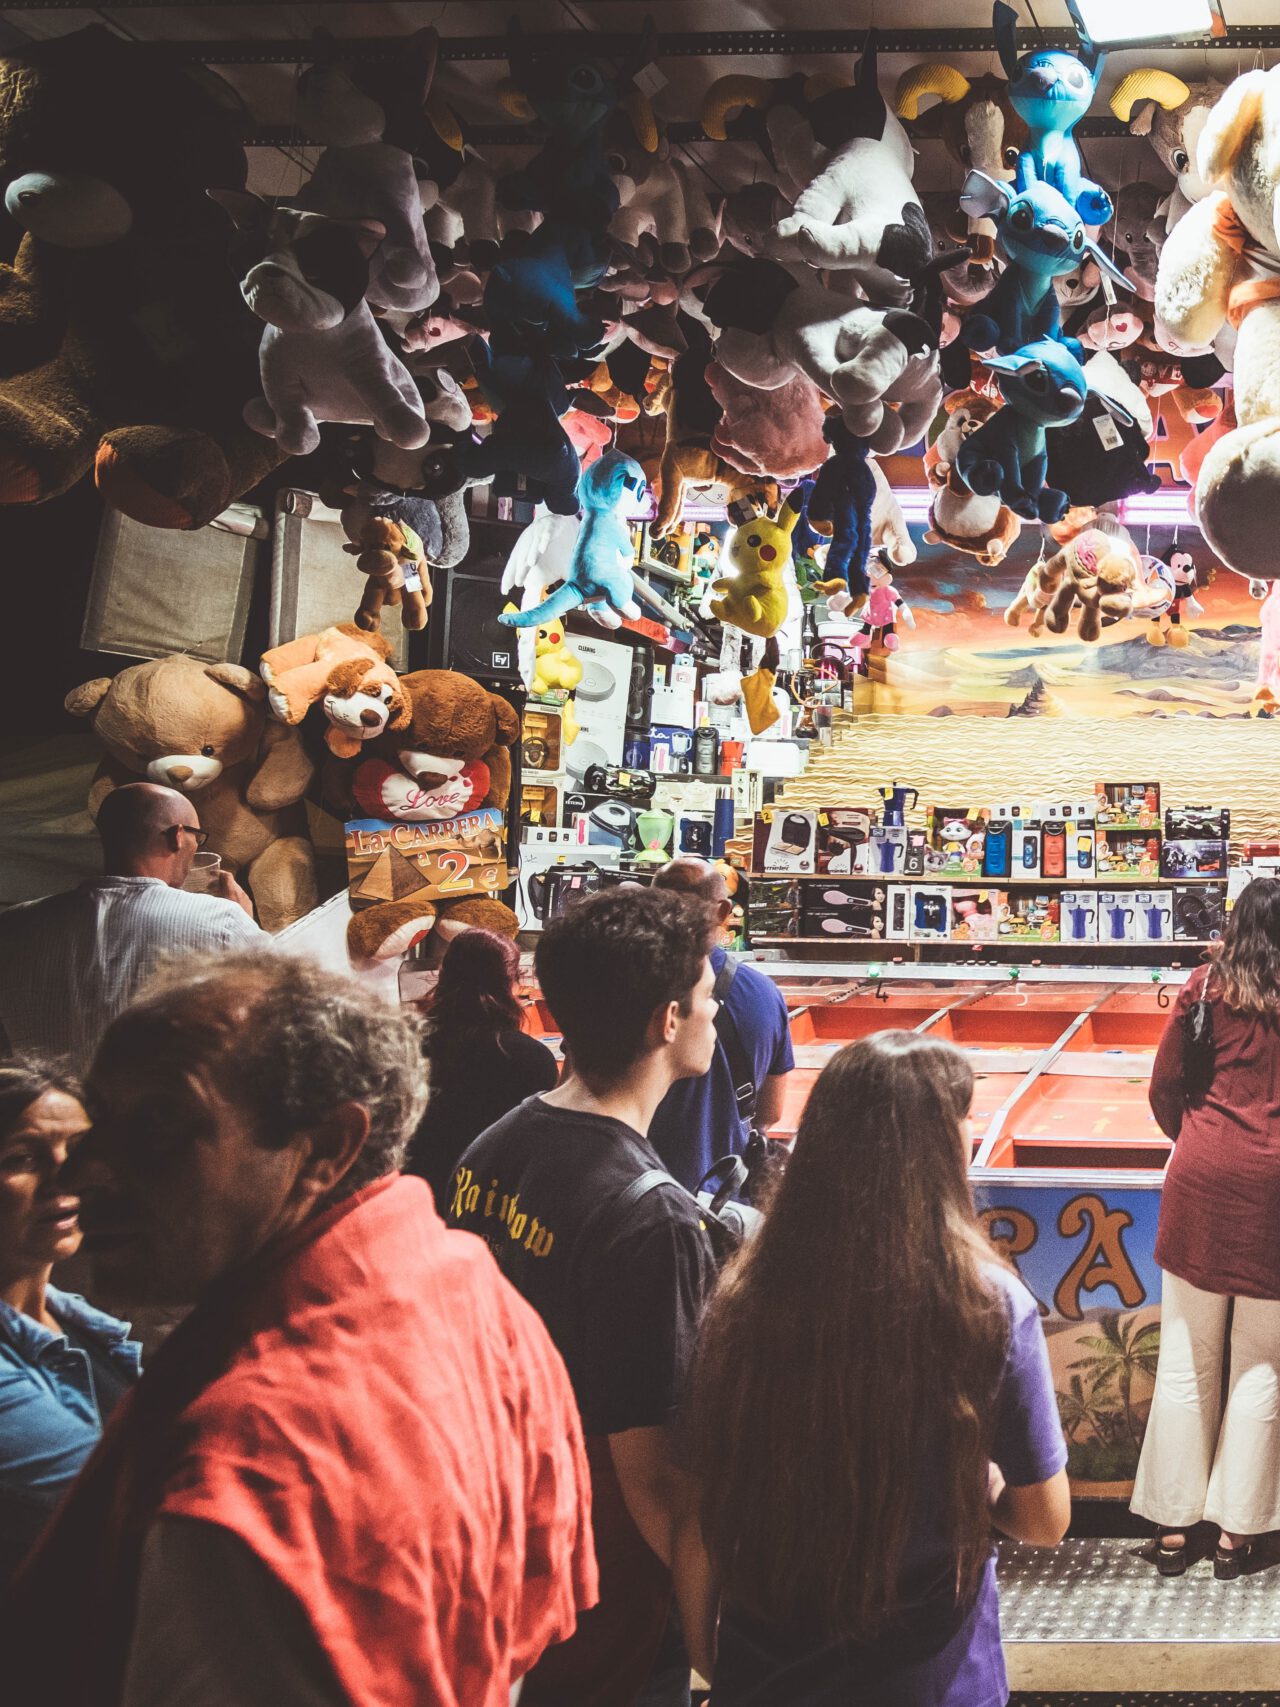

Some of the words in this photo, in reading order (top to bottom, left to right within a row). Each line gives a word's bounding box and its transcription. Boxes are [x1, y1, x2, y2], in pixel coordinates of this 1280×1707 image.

[400, 789, 460, 811] Love
[350, 829, 386, 856] La
[389, 812, 499, 849] CARRERA
[417, 852, 431, 867] a
[438, 850, 474, 892] 2
[479, 867, 500, 889] €
[909, 857, 918, 869] 6
[875, 982, 890, 1003] 4
[1015, 983, 1028, 1007] 5
[1157, 985, 1170, 1008] 6
